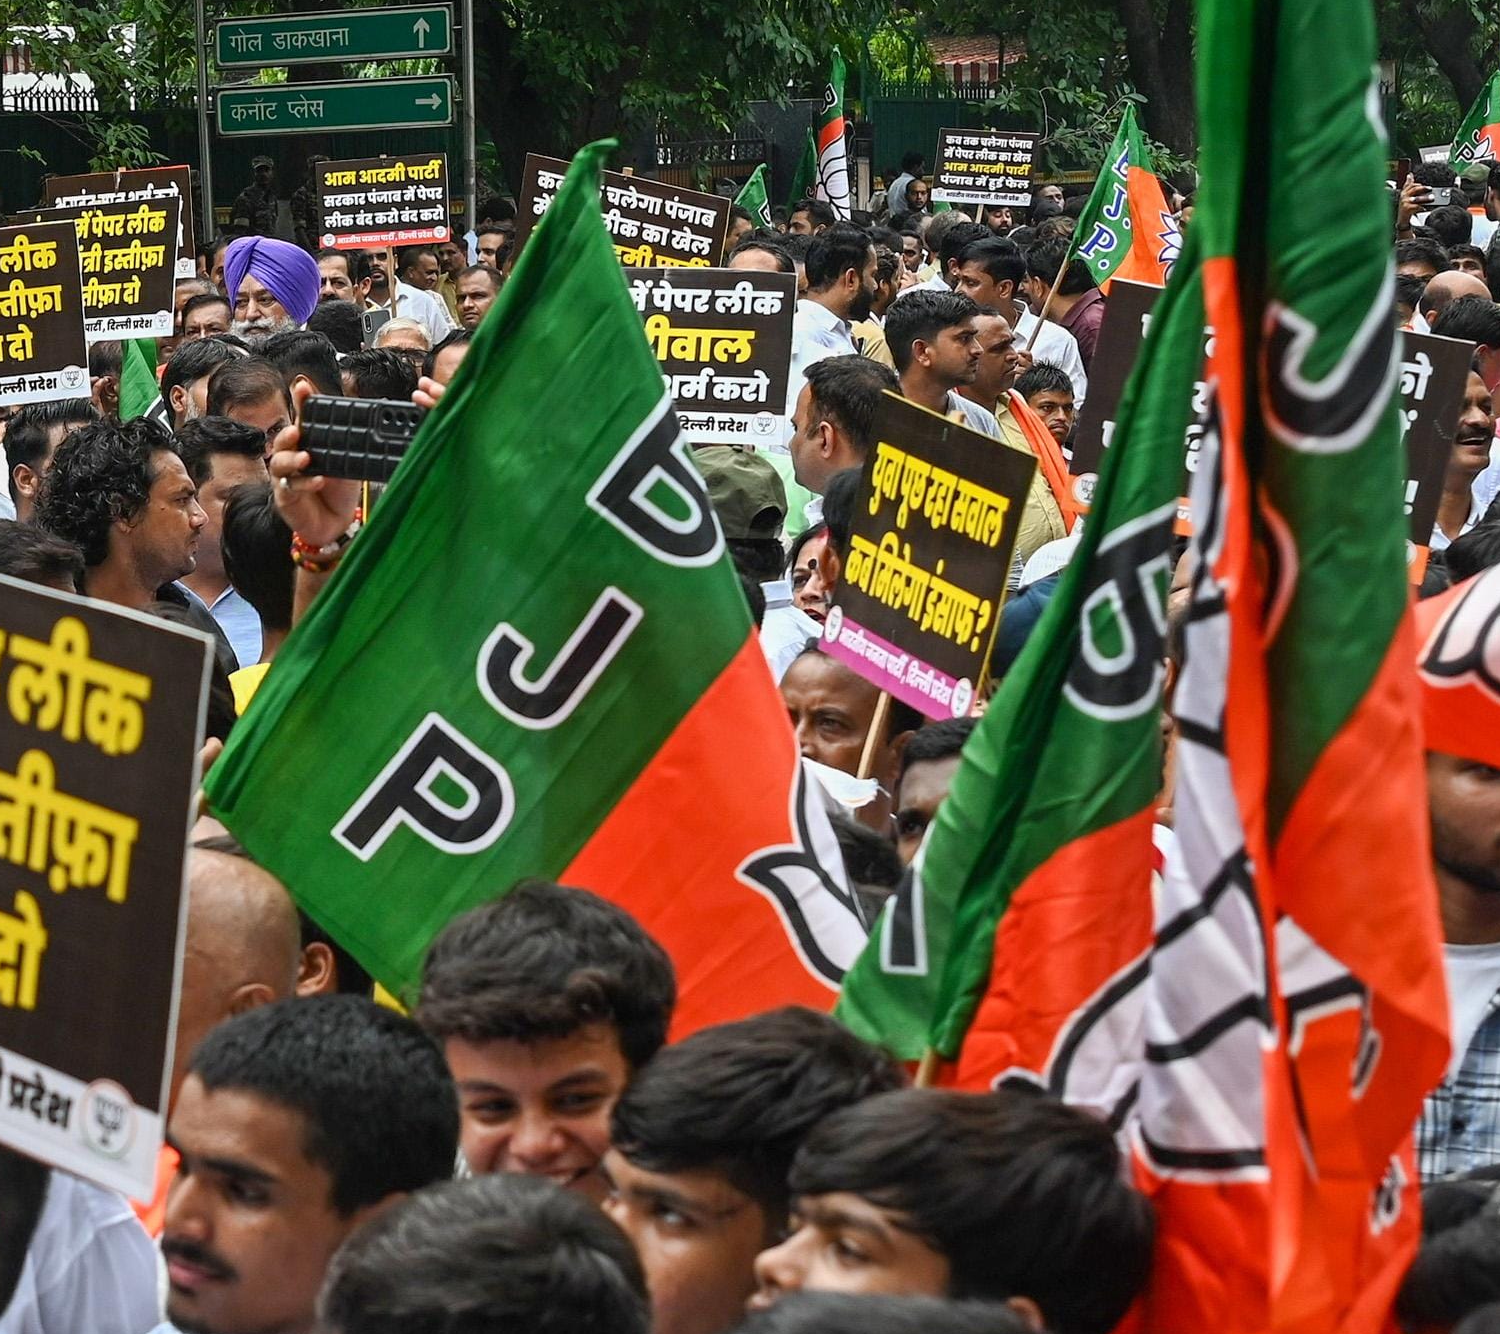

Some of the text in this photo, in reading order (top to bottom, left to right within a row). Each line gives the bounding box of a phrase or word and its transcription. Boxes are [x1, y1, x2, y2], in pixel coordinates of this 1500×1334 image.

[229, 28, 350, 52] गोल डाकखाना
[230, 94, 324, 121] कनॉट प्लेस
[324, 160, 442, 186] आम आदमी पार्टी
[323, 185, 443, 207] सरकार पंजाब में पेपर
[606, 185, 717, 229] चलेगा पंजाब
[652, 280, 784, 316] पेपर लीक
[7, 324, 34, 362] दो
[712, 369, 770, 403] करो
[869, 442, 1010, 548] युवा पूछ रहा सवाल
[845, 534, 877, 594] कब
[869, 531, 931, 622] मिलेगा
[6, 615, 153, 757] लीक
[6, 1073, 75, 1134] प्रदेश
